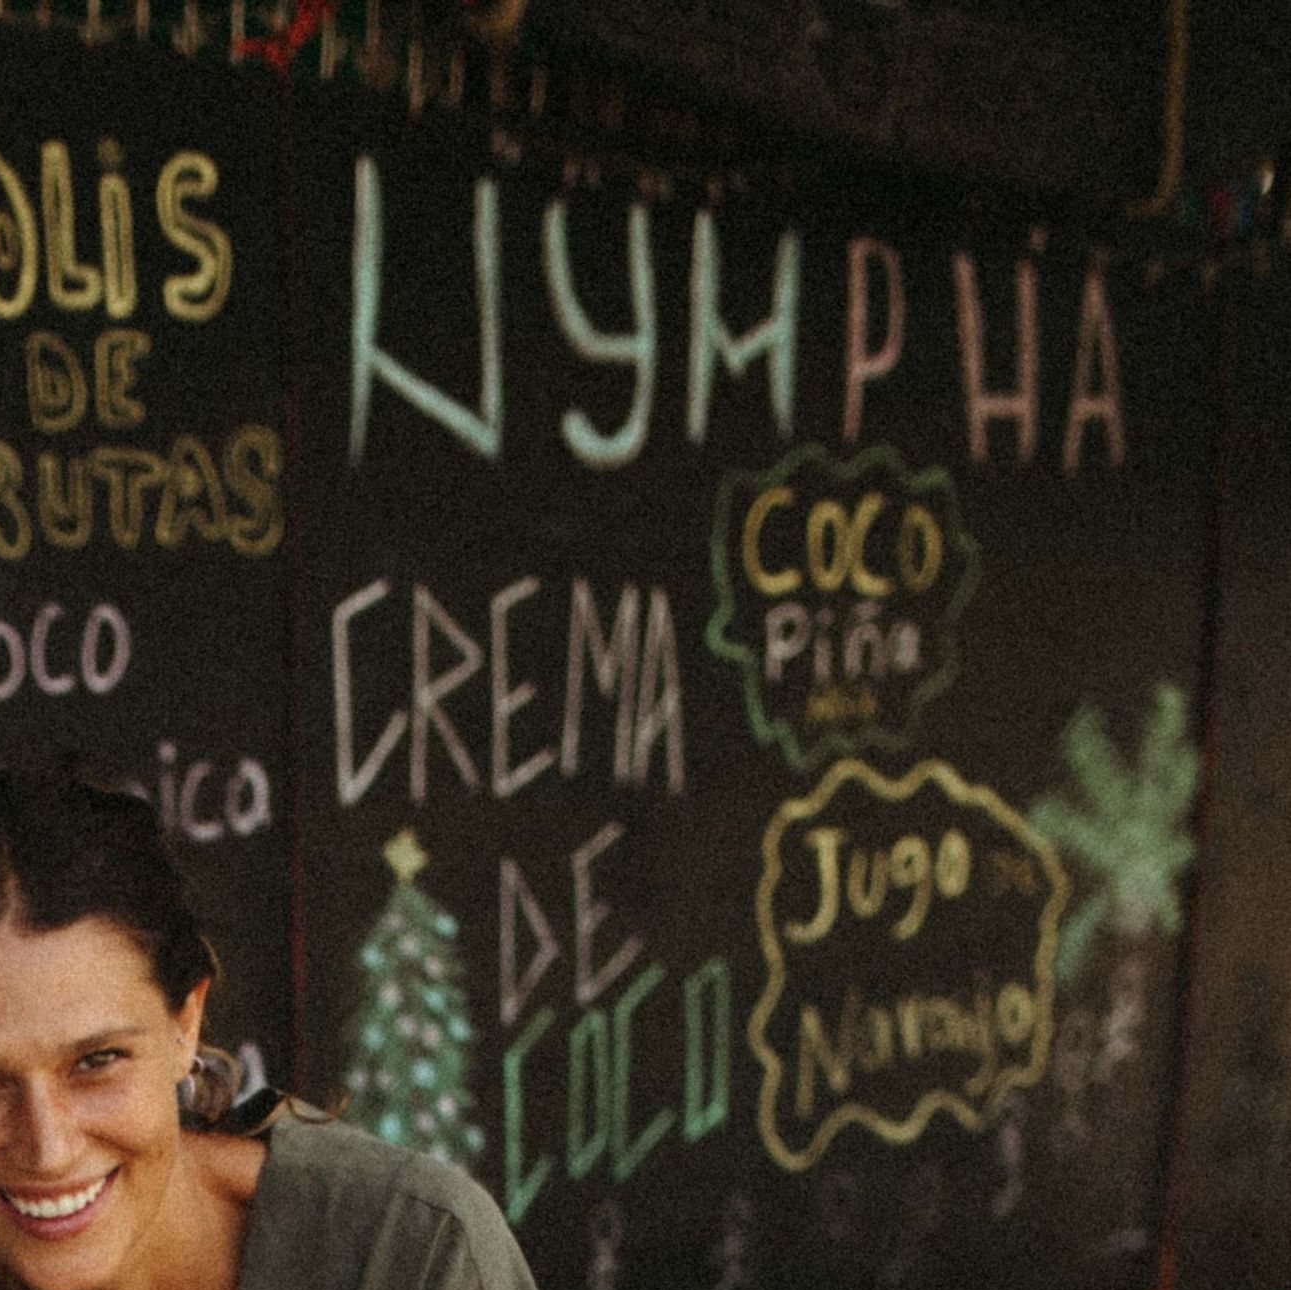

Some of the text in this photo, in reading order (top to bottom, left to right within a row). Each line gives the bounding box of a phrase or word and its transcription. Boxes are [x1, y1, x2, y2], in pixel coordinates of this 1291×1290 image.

[25, 328, 152, 432] DE
[330, 576, 686, 806] CREMA
[499, 821, 644, 1026] DE
[783, 822, 972, 944] Jugo
[501, 958, 731, 1224] COCO
